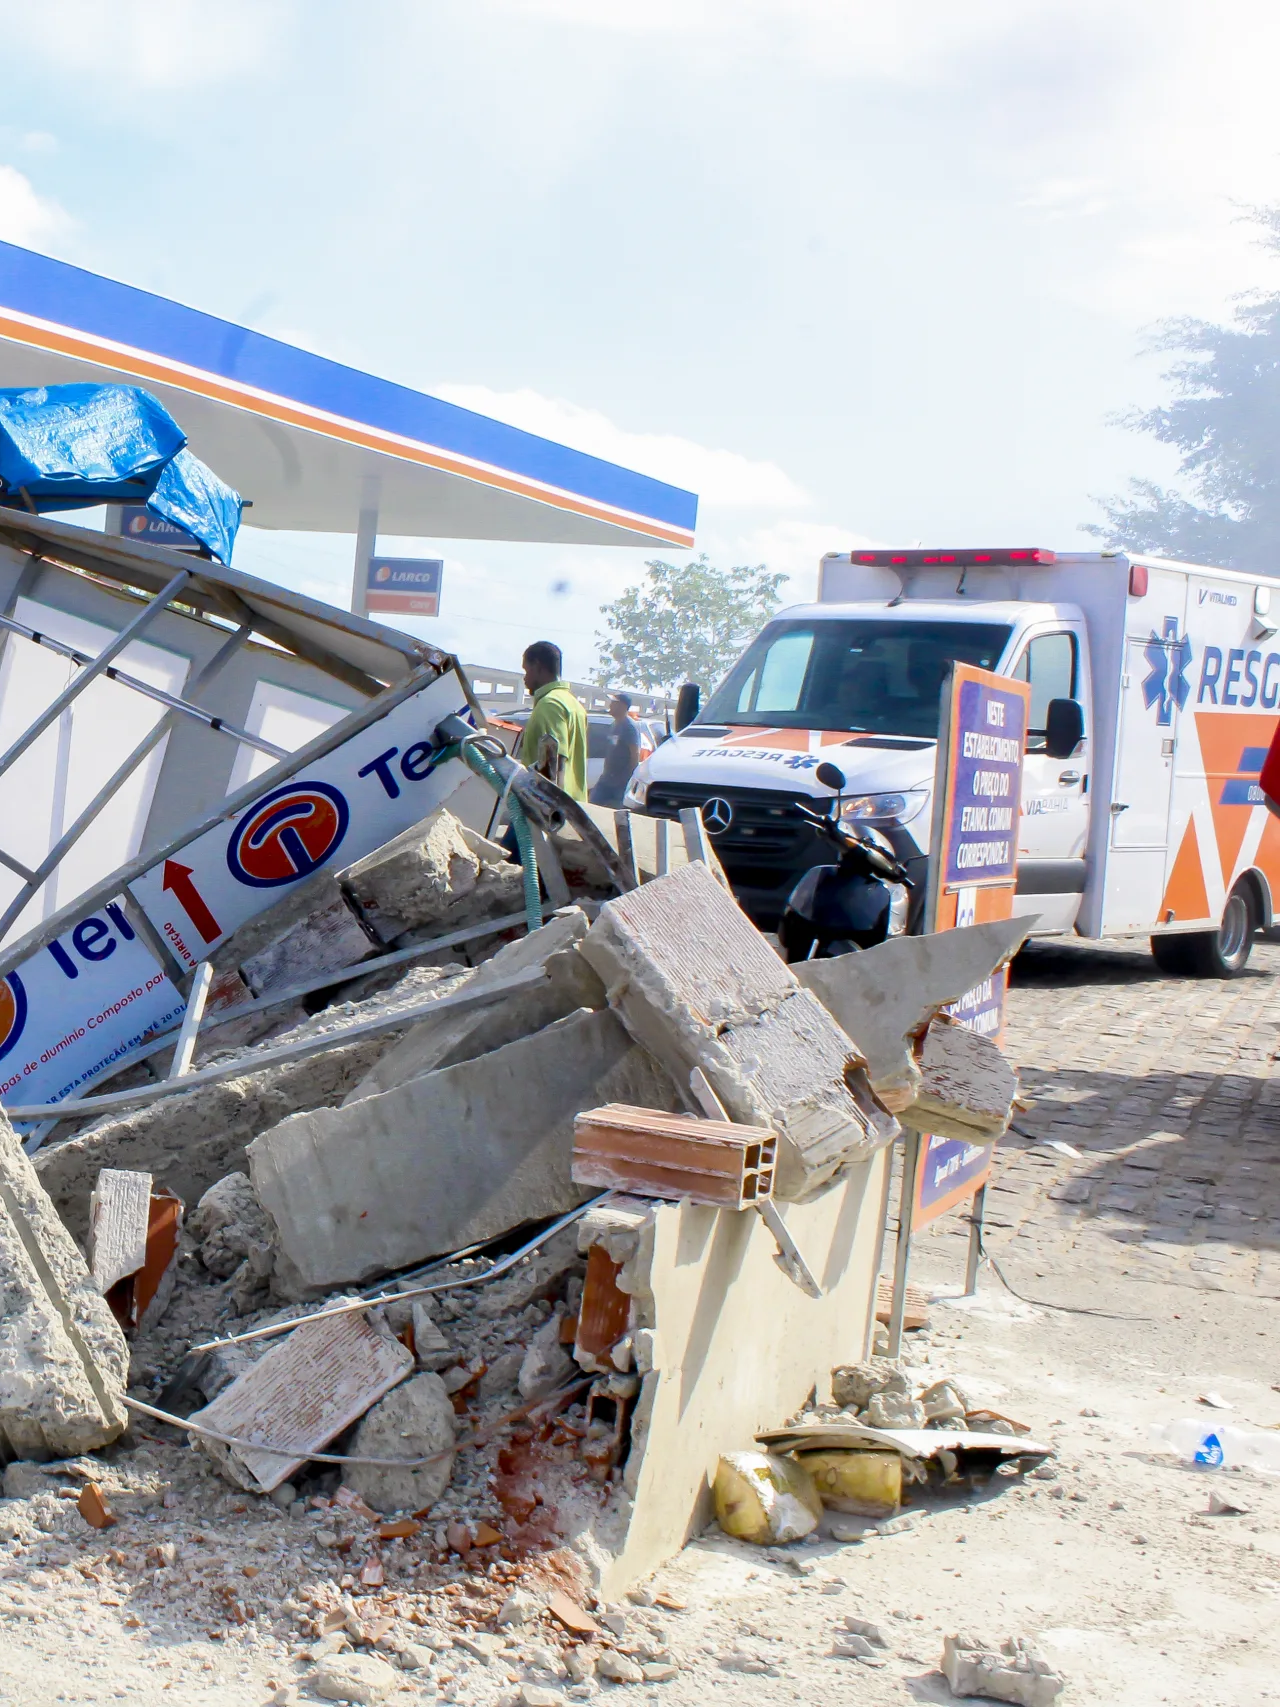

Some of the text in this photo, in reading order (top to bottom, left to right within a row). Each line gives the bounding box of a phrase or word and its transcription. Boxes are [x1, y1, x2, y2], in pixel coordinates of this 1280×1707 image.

[392, 571, 431, 583] LARCO
[1196, 645, 1280, 709] RESG
[986, 700, 1005, 727] NESTE
[963, 732, 1020, 766] ESTABELECIMENTO,
[973, 771, 1009, 803] O PREÇO DO
[961, 806, 1013, 832] ETANOL COMUM
[957, 843, 1004, 869] CORRESPONDE
[163, 922, 192, 960] DIREÇÃO
[23, 1060, 38, 1077] de
[40, 1027, 86, 1063] alumínio
[87, 987, 144, 1029] Composto
[59, 1079, 82, 1099] ESTA
[81, 1044, 128, 1082] PROTEÇÃO
[128, 1034, 142, 1048] EM
[143, 1020, 160, 1037] ATÉ
[160, 1014, 173, 1025] 20
